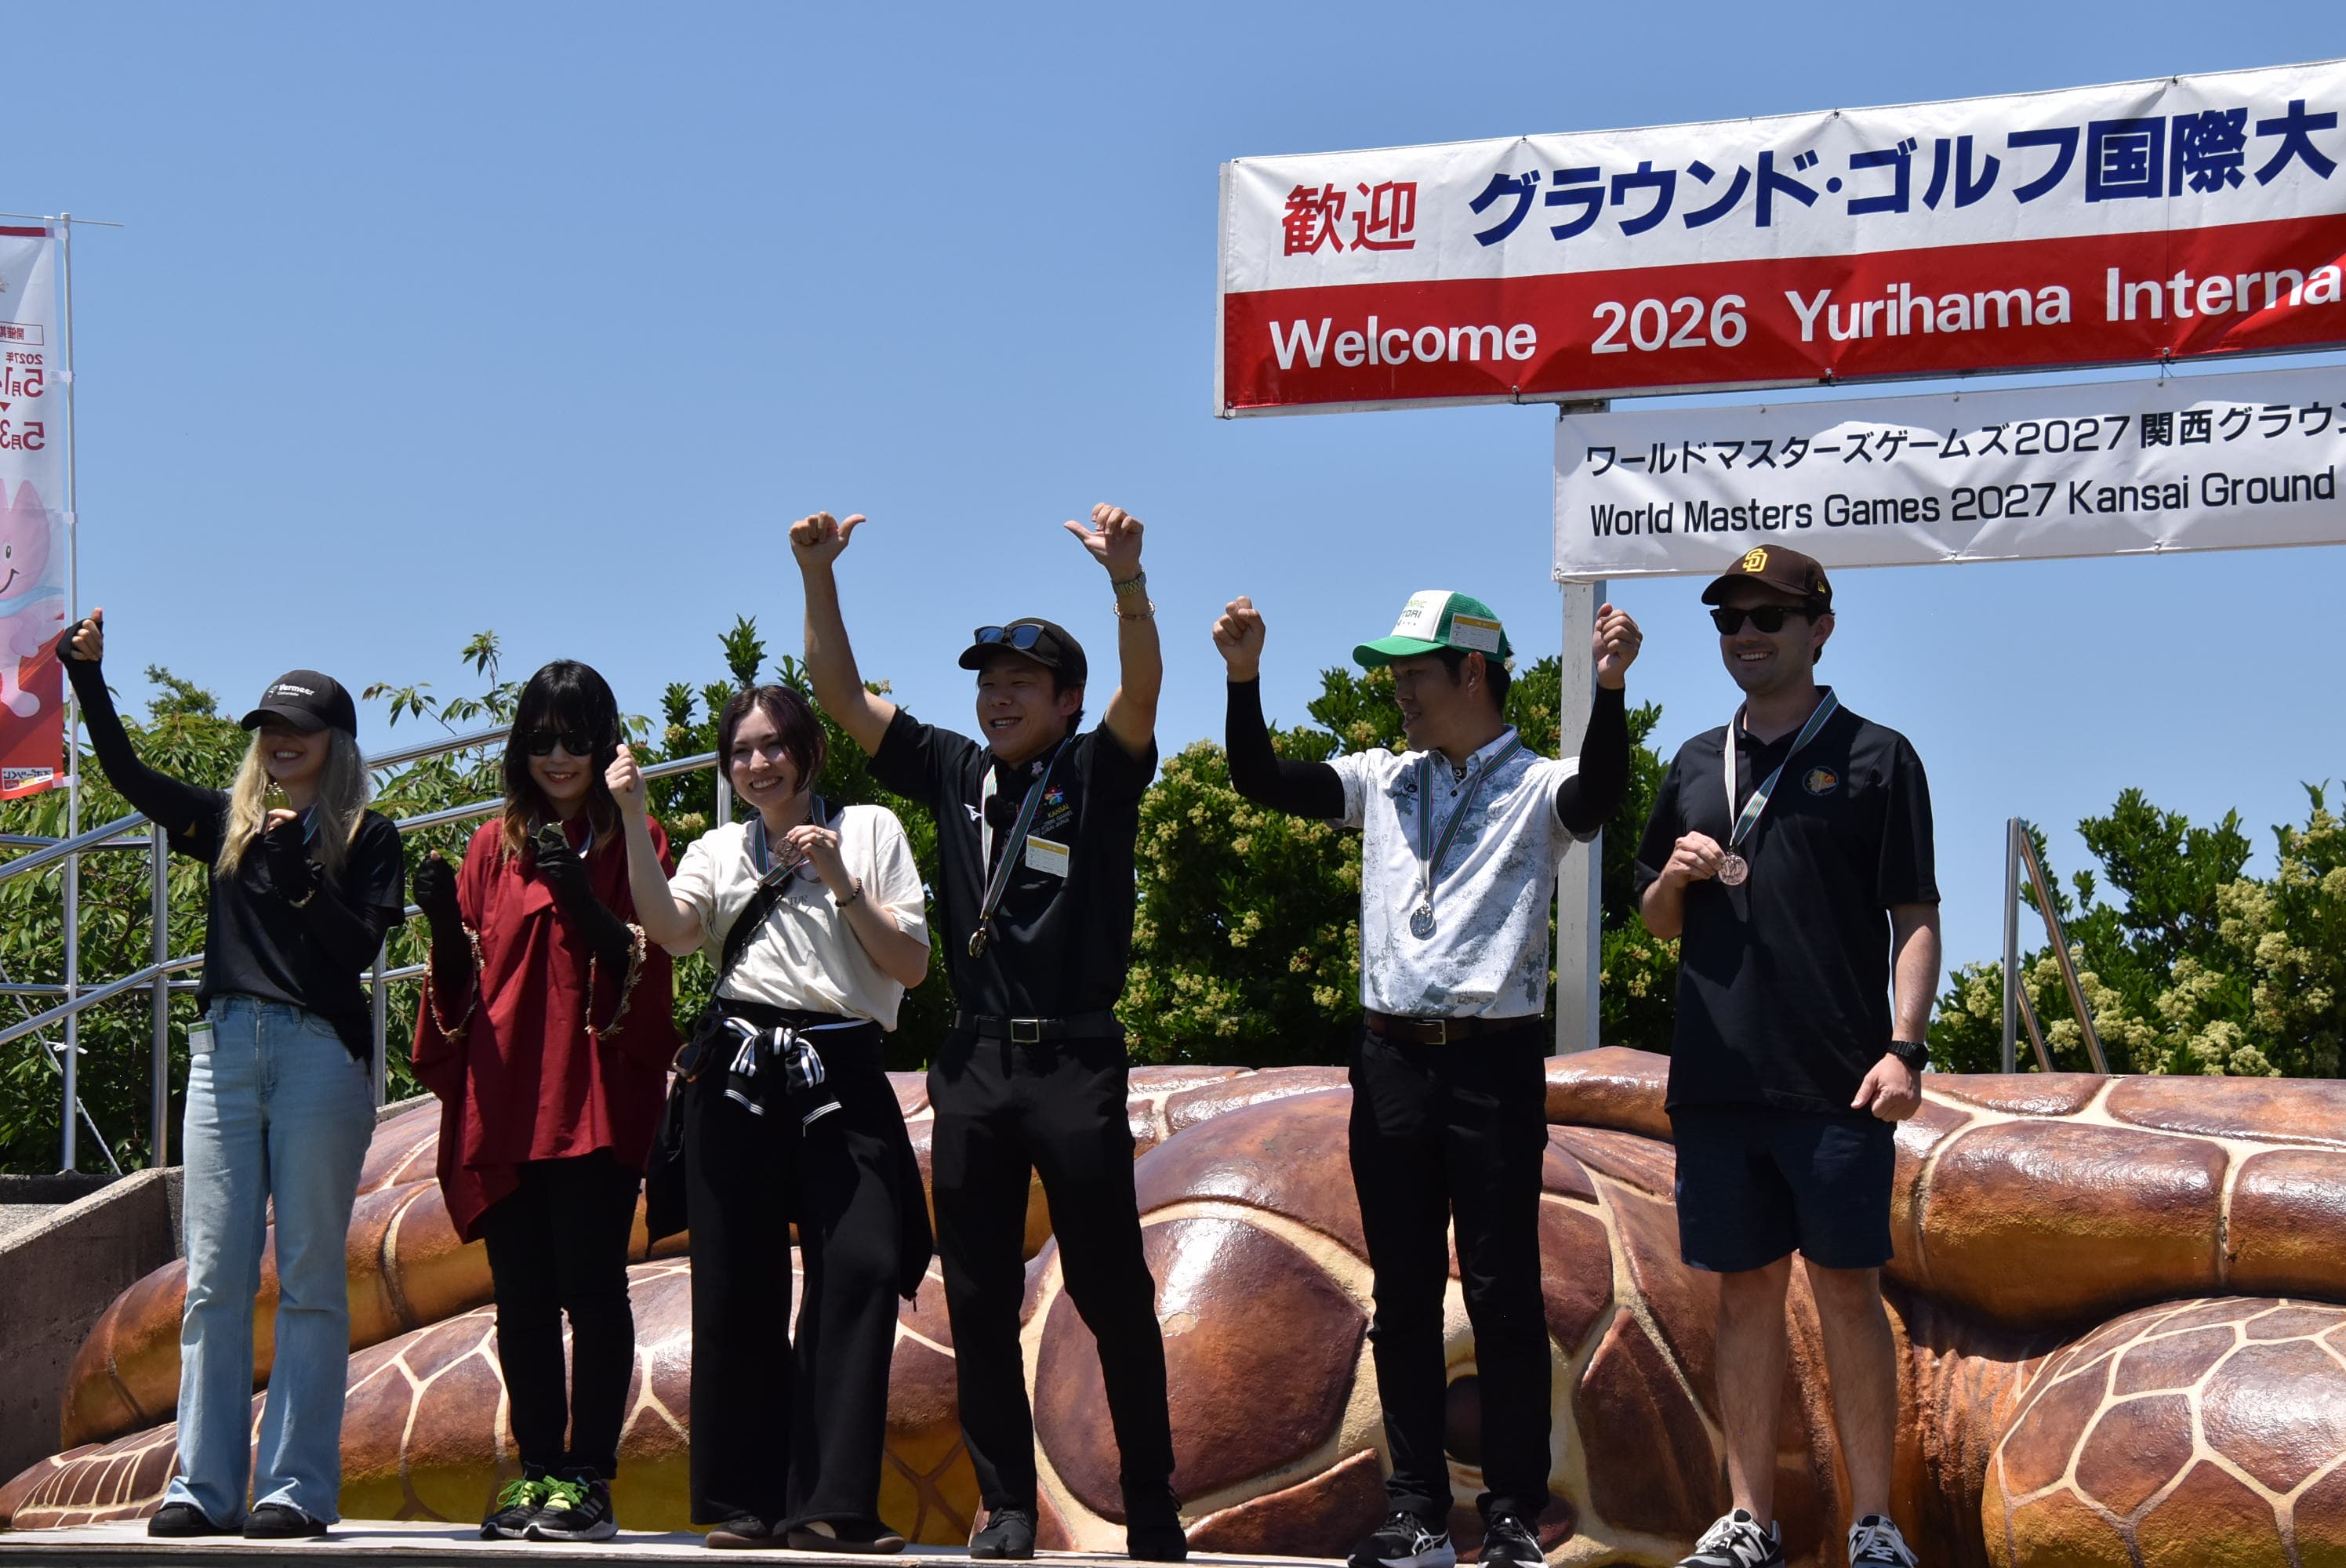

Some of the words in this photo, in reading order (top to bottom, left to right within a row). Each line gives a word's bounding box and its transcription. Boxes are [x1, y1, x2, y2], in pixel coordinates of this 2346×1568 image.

[1283, 182, 1417, 256] 歓迎
[1269, 315, 1537, 370] Welcome
[1591, 294, 1747, 354] 2026
[1784, 282, 2071, 342] Yurihama
[2106, 264, 2342, 321] Interna
[1590, 502, 1674, 537] World
[1684, 498, 1813, 533] Masters
[1825, 494, 1941, 528] Games
[1951, 481, 2057, 521] 2027
[2069, 475, 2189, 515] Kansai
[2202, 465, 2336, 506] Ground
